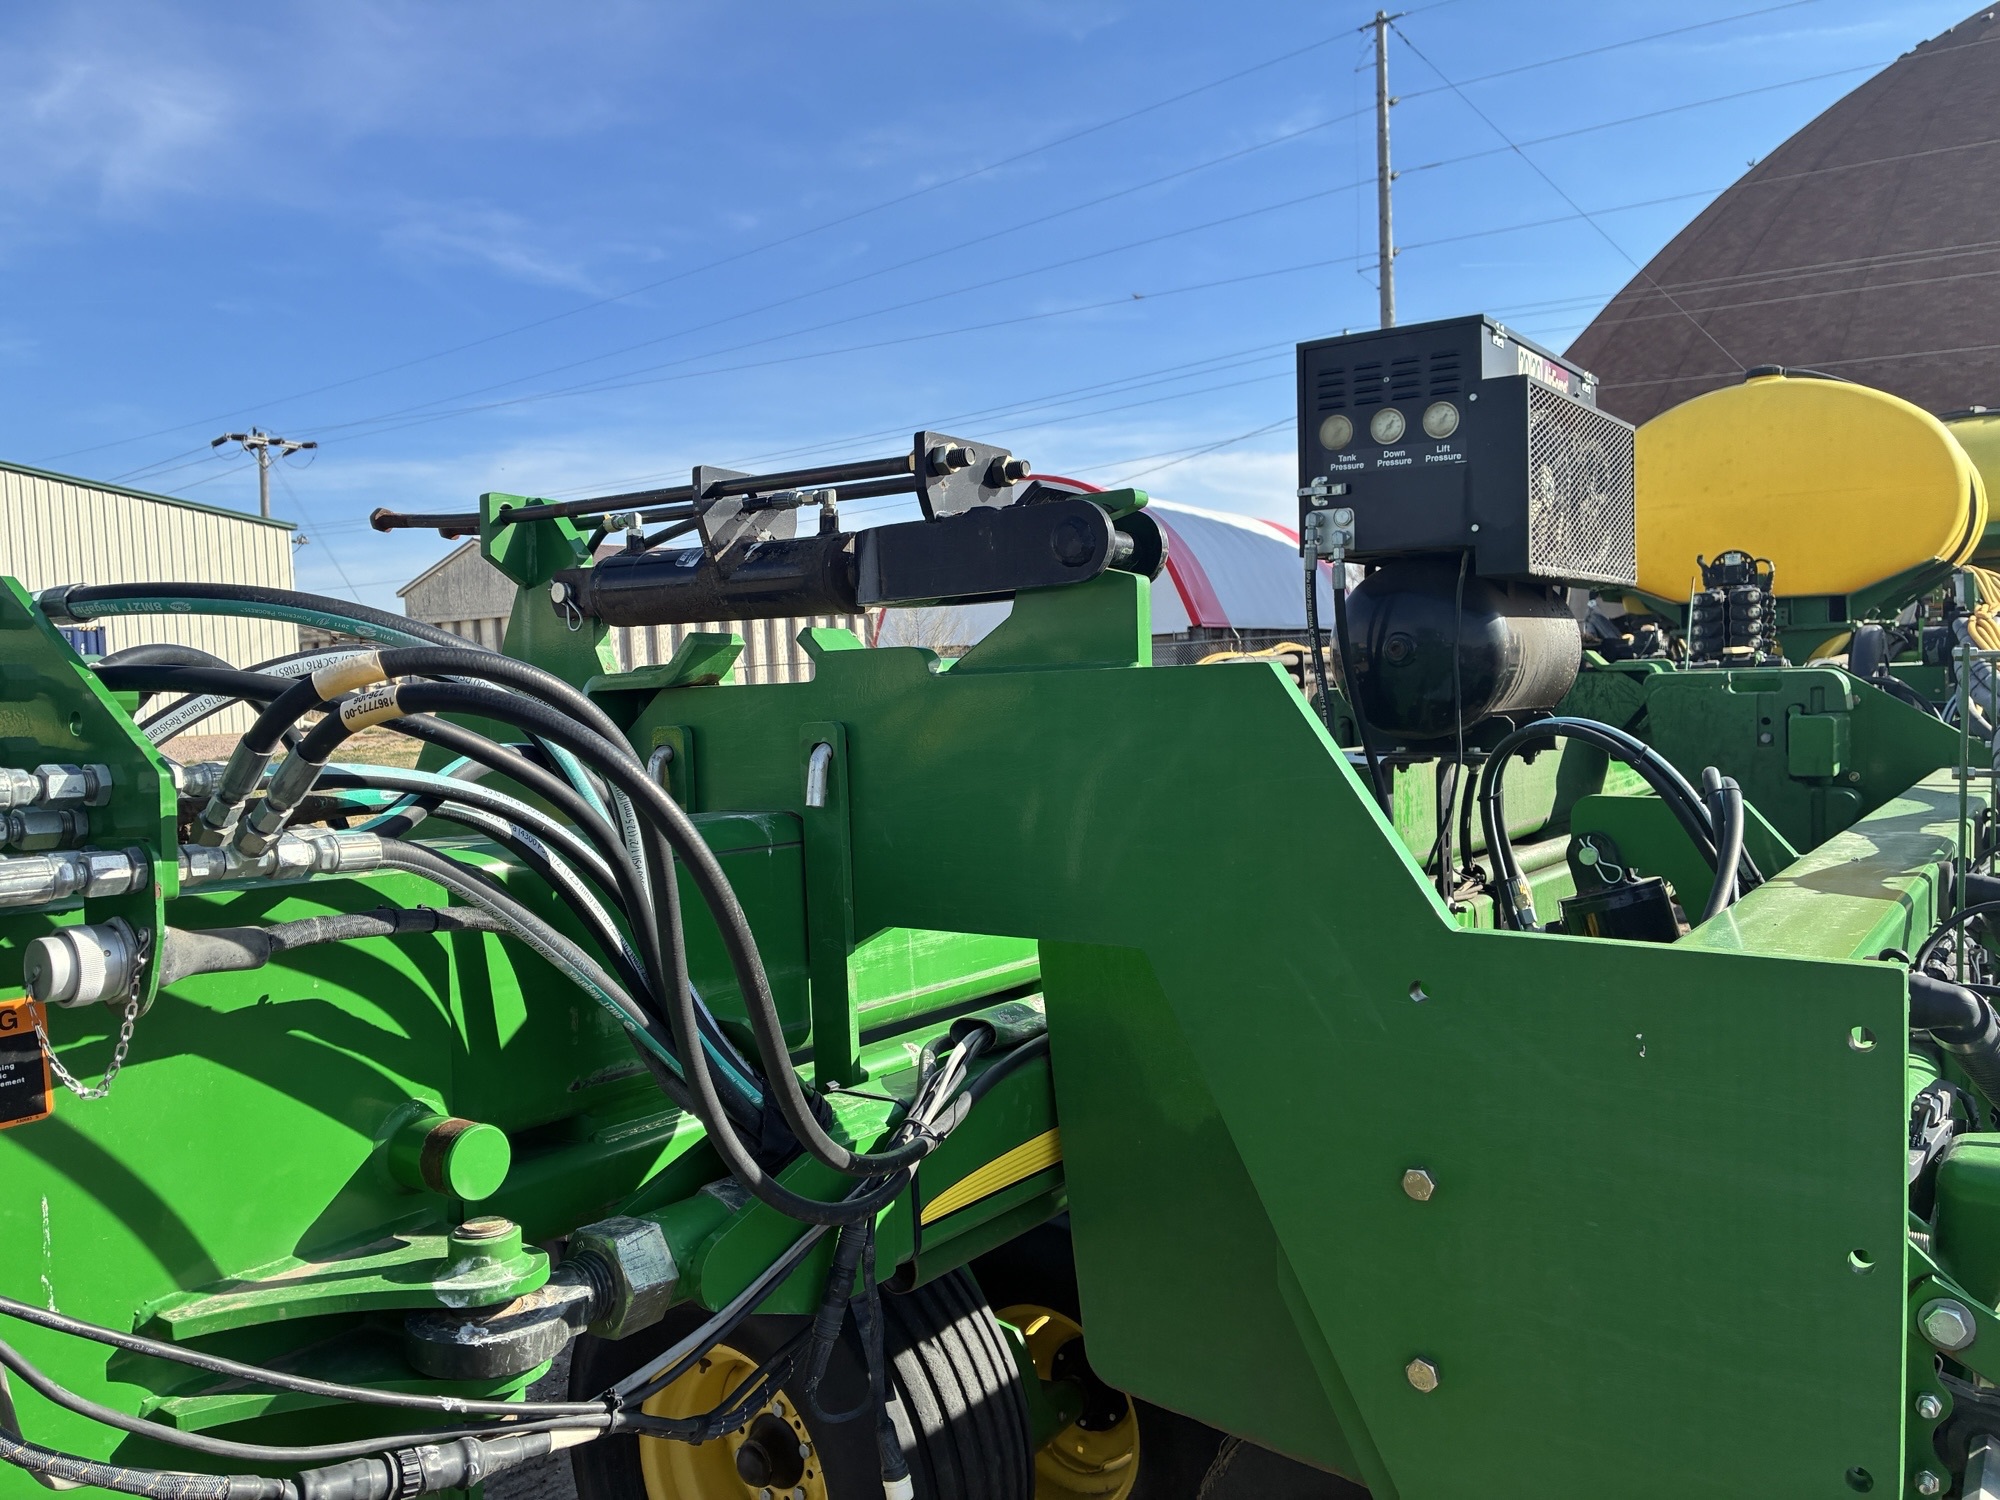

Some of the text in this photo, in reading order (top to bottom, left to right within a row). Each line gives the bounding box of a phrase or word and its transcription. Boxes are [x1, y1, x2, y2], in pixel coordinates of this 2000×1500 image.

[1436, 444, 1451, 453] Lift
[1338, 454, 1357, 462] Tank
[1383, 450, 1406, 459] Down
[1425, 453, 1462, 463] Pressure
[1330, 462, 1364, 471] Pressure
[1377, 458, 1412, 467] Pressure
[334, 622, 350, 630] 2011
[379, 633, 394, 641] 1911
[180, 701, 206, 719] Flame
[345, 696, 394, 720] 1867773-00
[567, 967, 602, 1000] MegaFlex
[0, 1063, 15, 1072] ing
